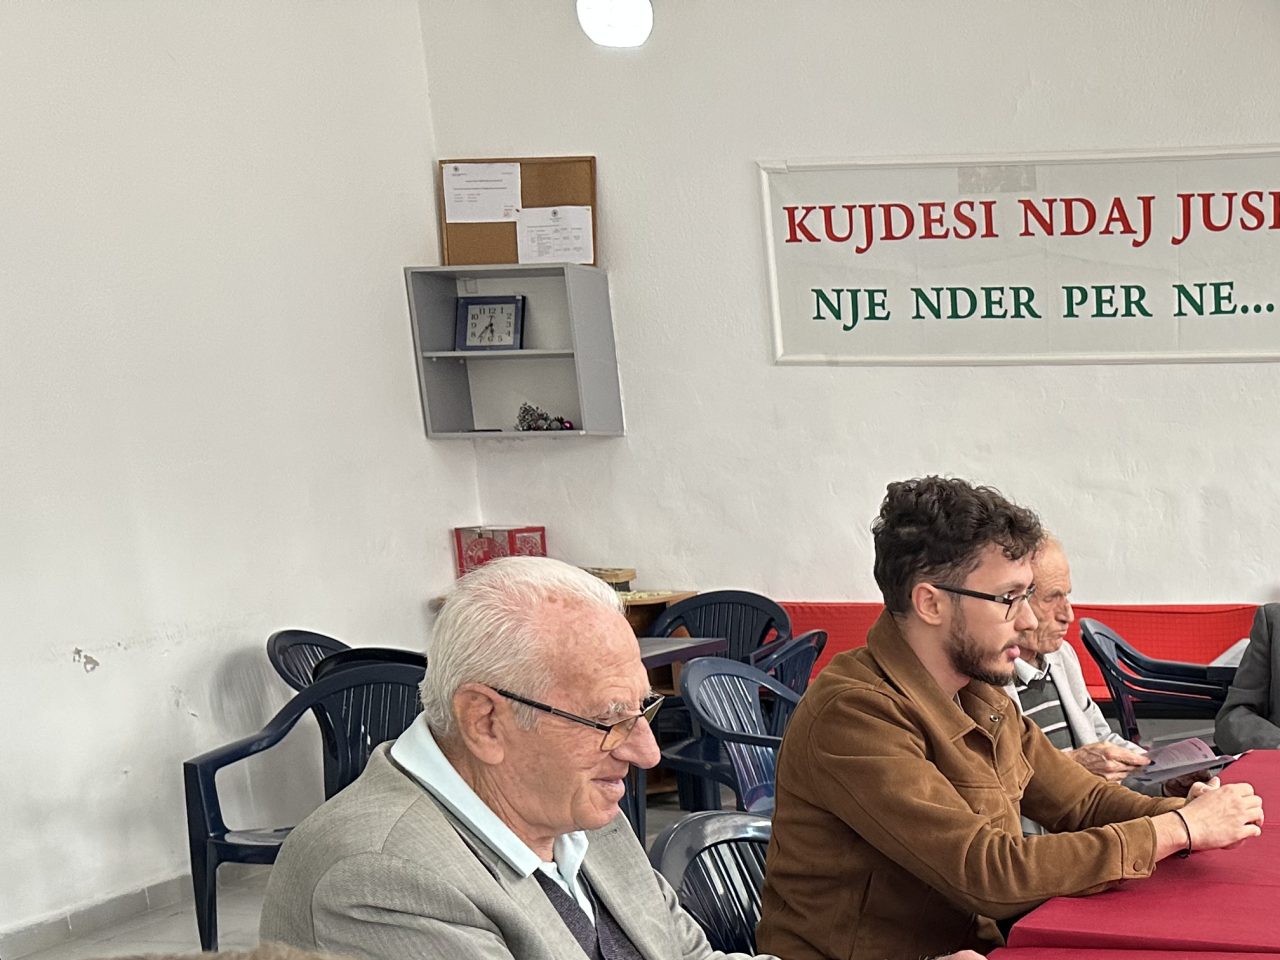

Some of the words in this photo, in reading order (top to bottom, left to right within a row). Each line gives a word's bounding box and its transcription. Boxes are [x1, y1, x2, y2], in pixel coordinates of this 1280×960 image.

[784, 200, 1000, 254] KUJDESI
[1019, 195, 1156, 248] NDAJ
[811, 286, 891, 332] NJE
[911, 285, 1042, 321] NDER
[1062, 284, 1153, 319] PER
[1173, 281, 1275, 317] NE...
